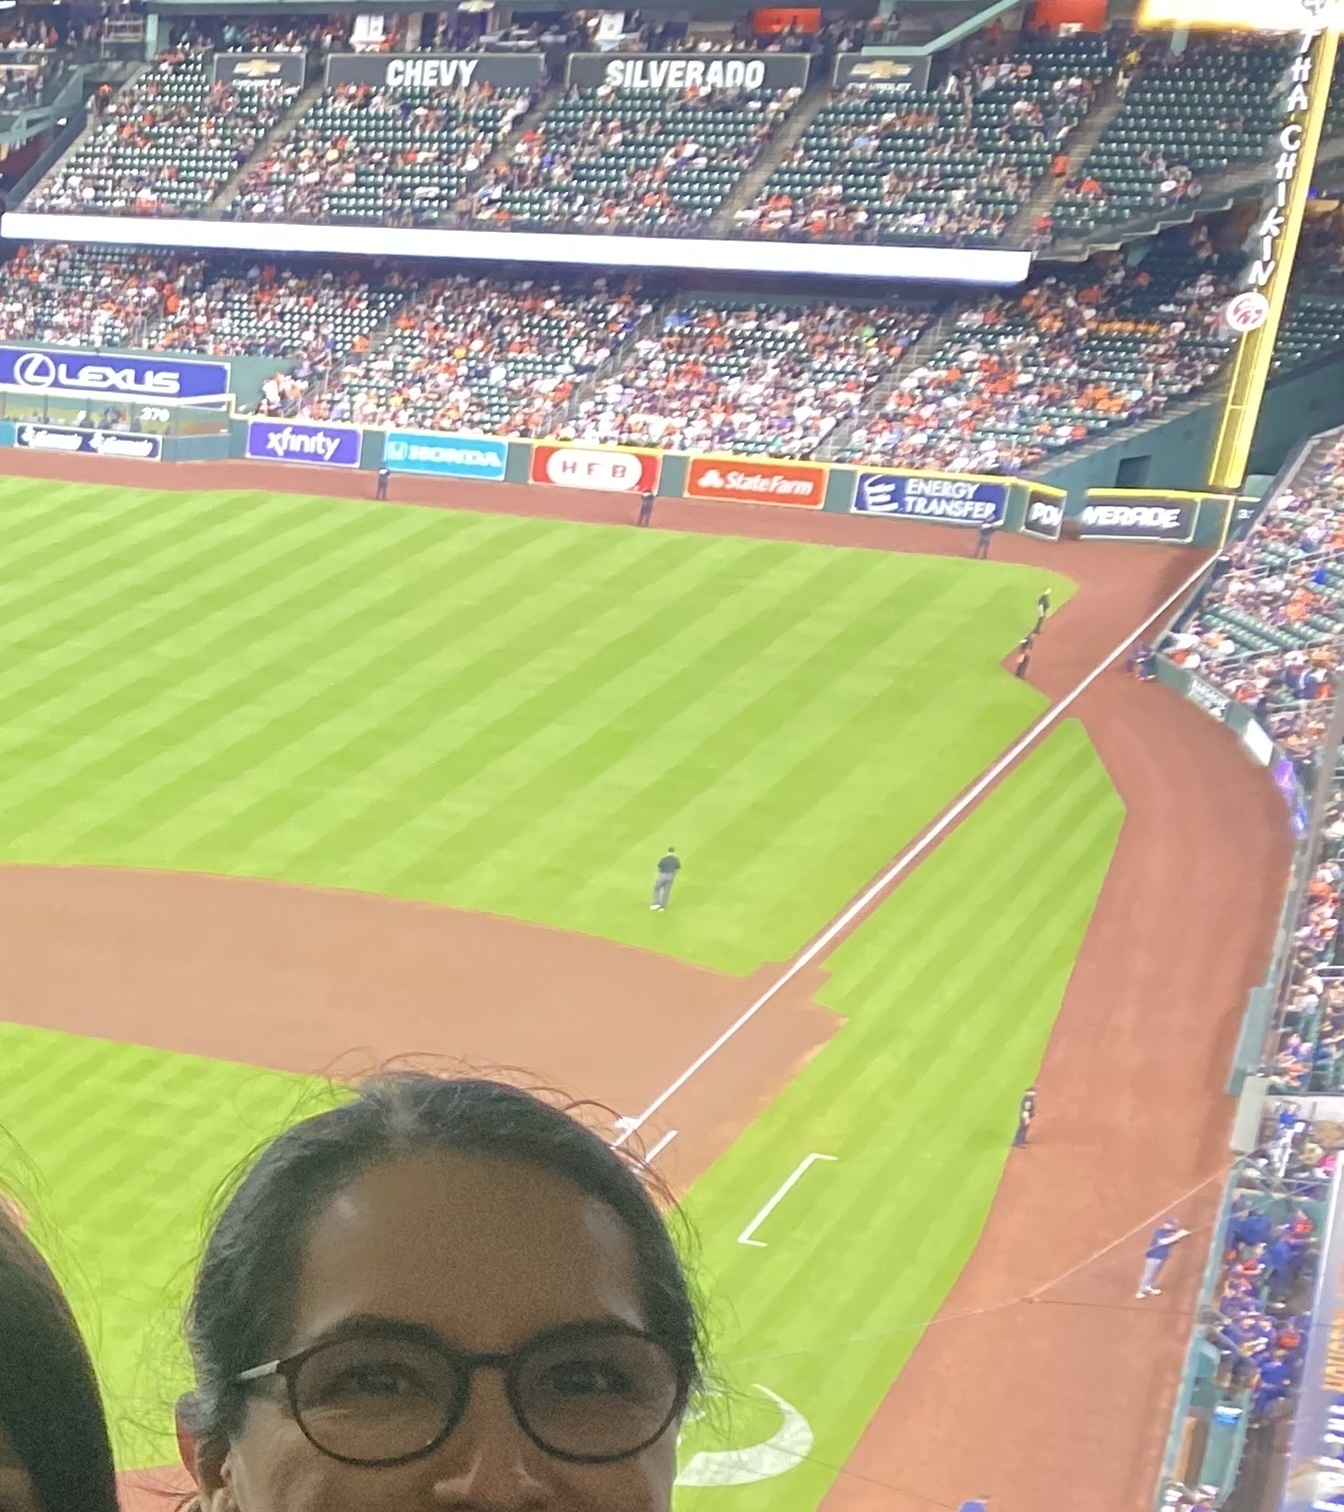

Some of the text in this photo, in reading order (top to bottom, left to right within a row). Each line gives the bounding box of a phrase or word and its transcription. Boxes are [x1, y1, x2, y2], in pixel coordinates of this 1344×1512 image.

[385, 59, 479, 87] CHEVY
[605, 59, 765, 89] SILVERADO
[1247, 124, 1303, 286] CHIKIN
[57, 363, 180, 394] LEXUS
[266, 428, 341, 461] xfinity
[409, 445, 502, 467] HONDA
[906, 478, 980, 498] ENERGY
[903, 496, 996, 519] TRANSFER
